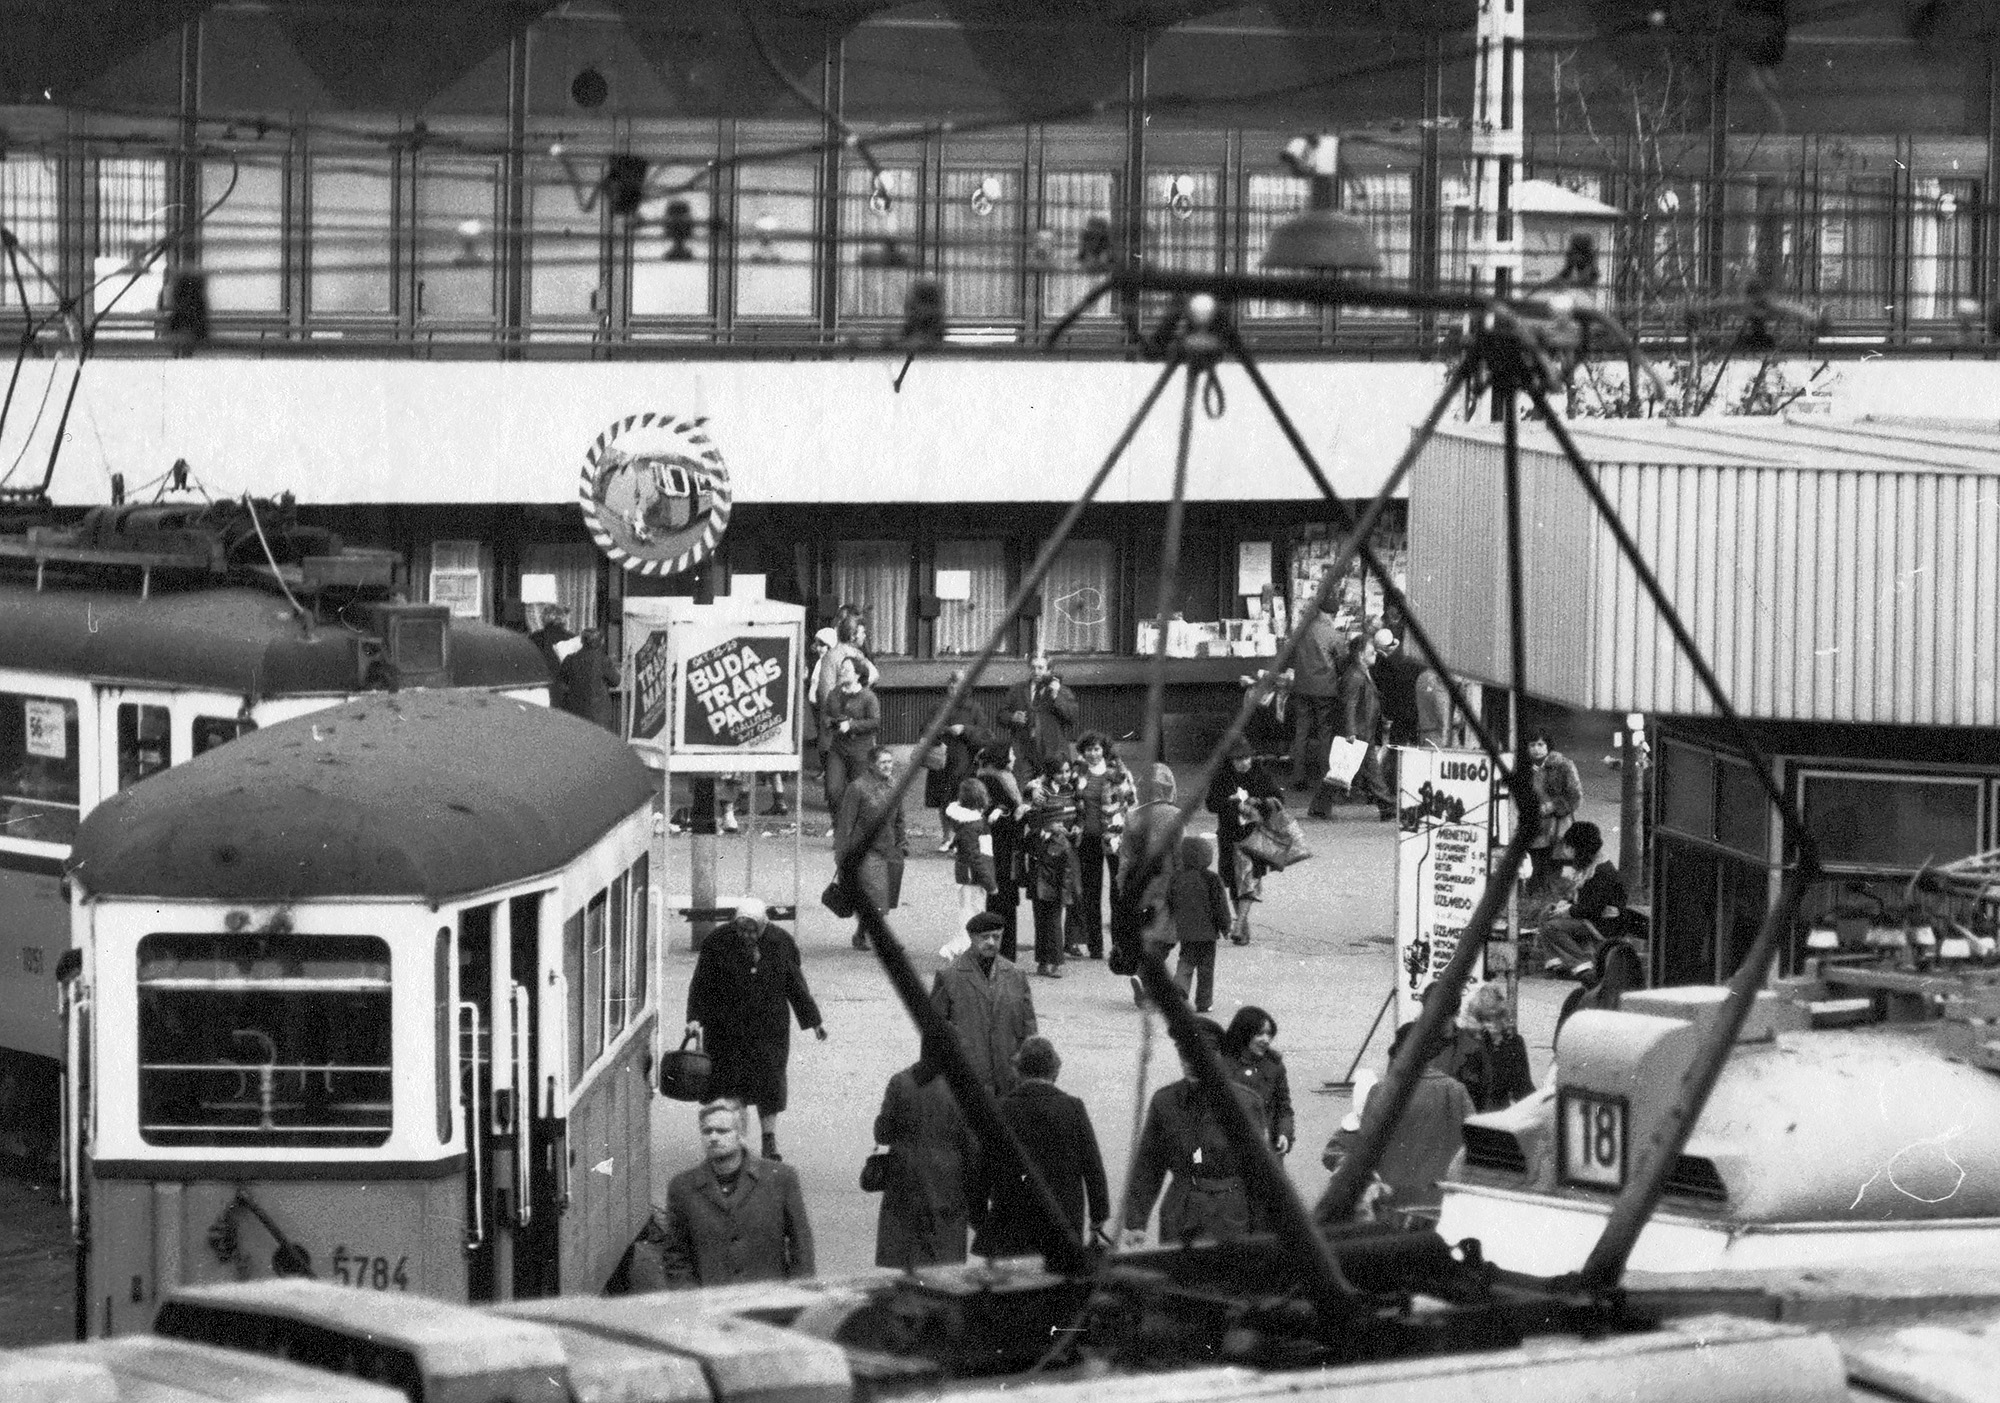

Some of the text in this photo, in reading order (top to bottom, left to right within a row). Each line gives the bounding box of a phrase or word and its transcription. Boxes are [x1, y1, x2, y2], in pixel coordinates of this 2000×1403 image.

[687, 645, 761, 692] BUDA
[697, 657, 782, 713] TRANS
[707, 685, 774, 735] PACK
[1440, 758, 1488, 782] LIBEGŐ
[1579, 1101, 1616, 1168] 18
[332, 1245, 409, 1292] 5784
